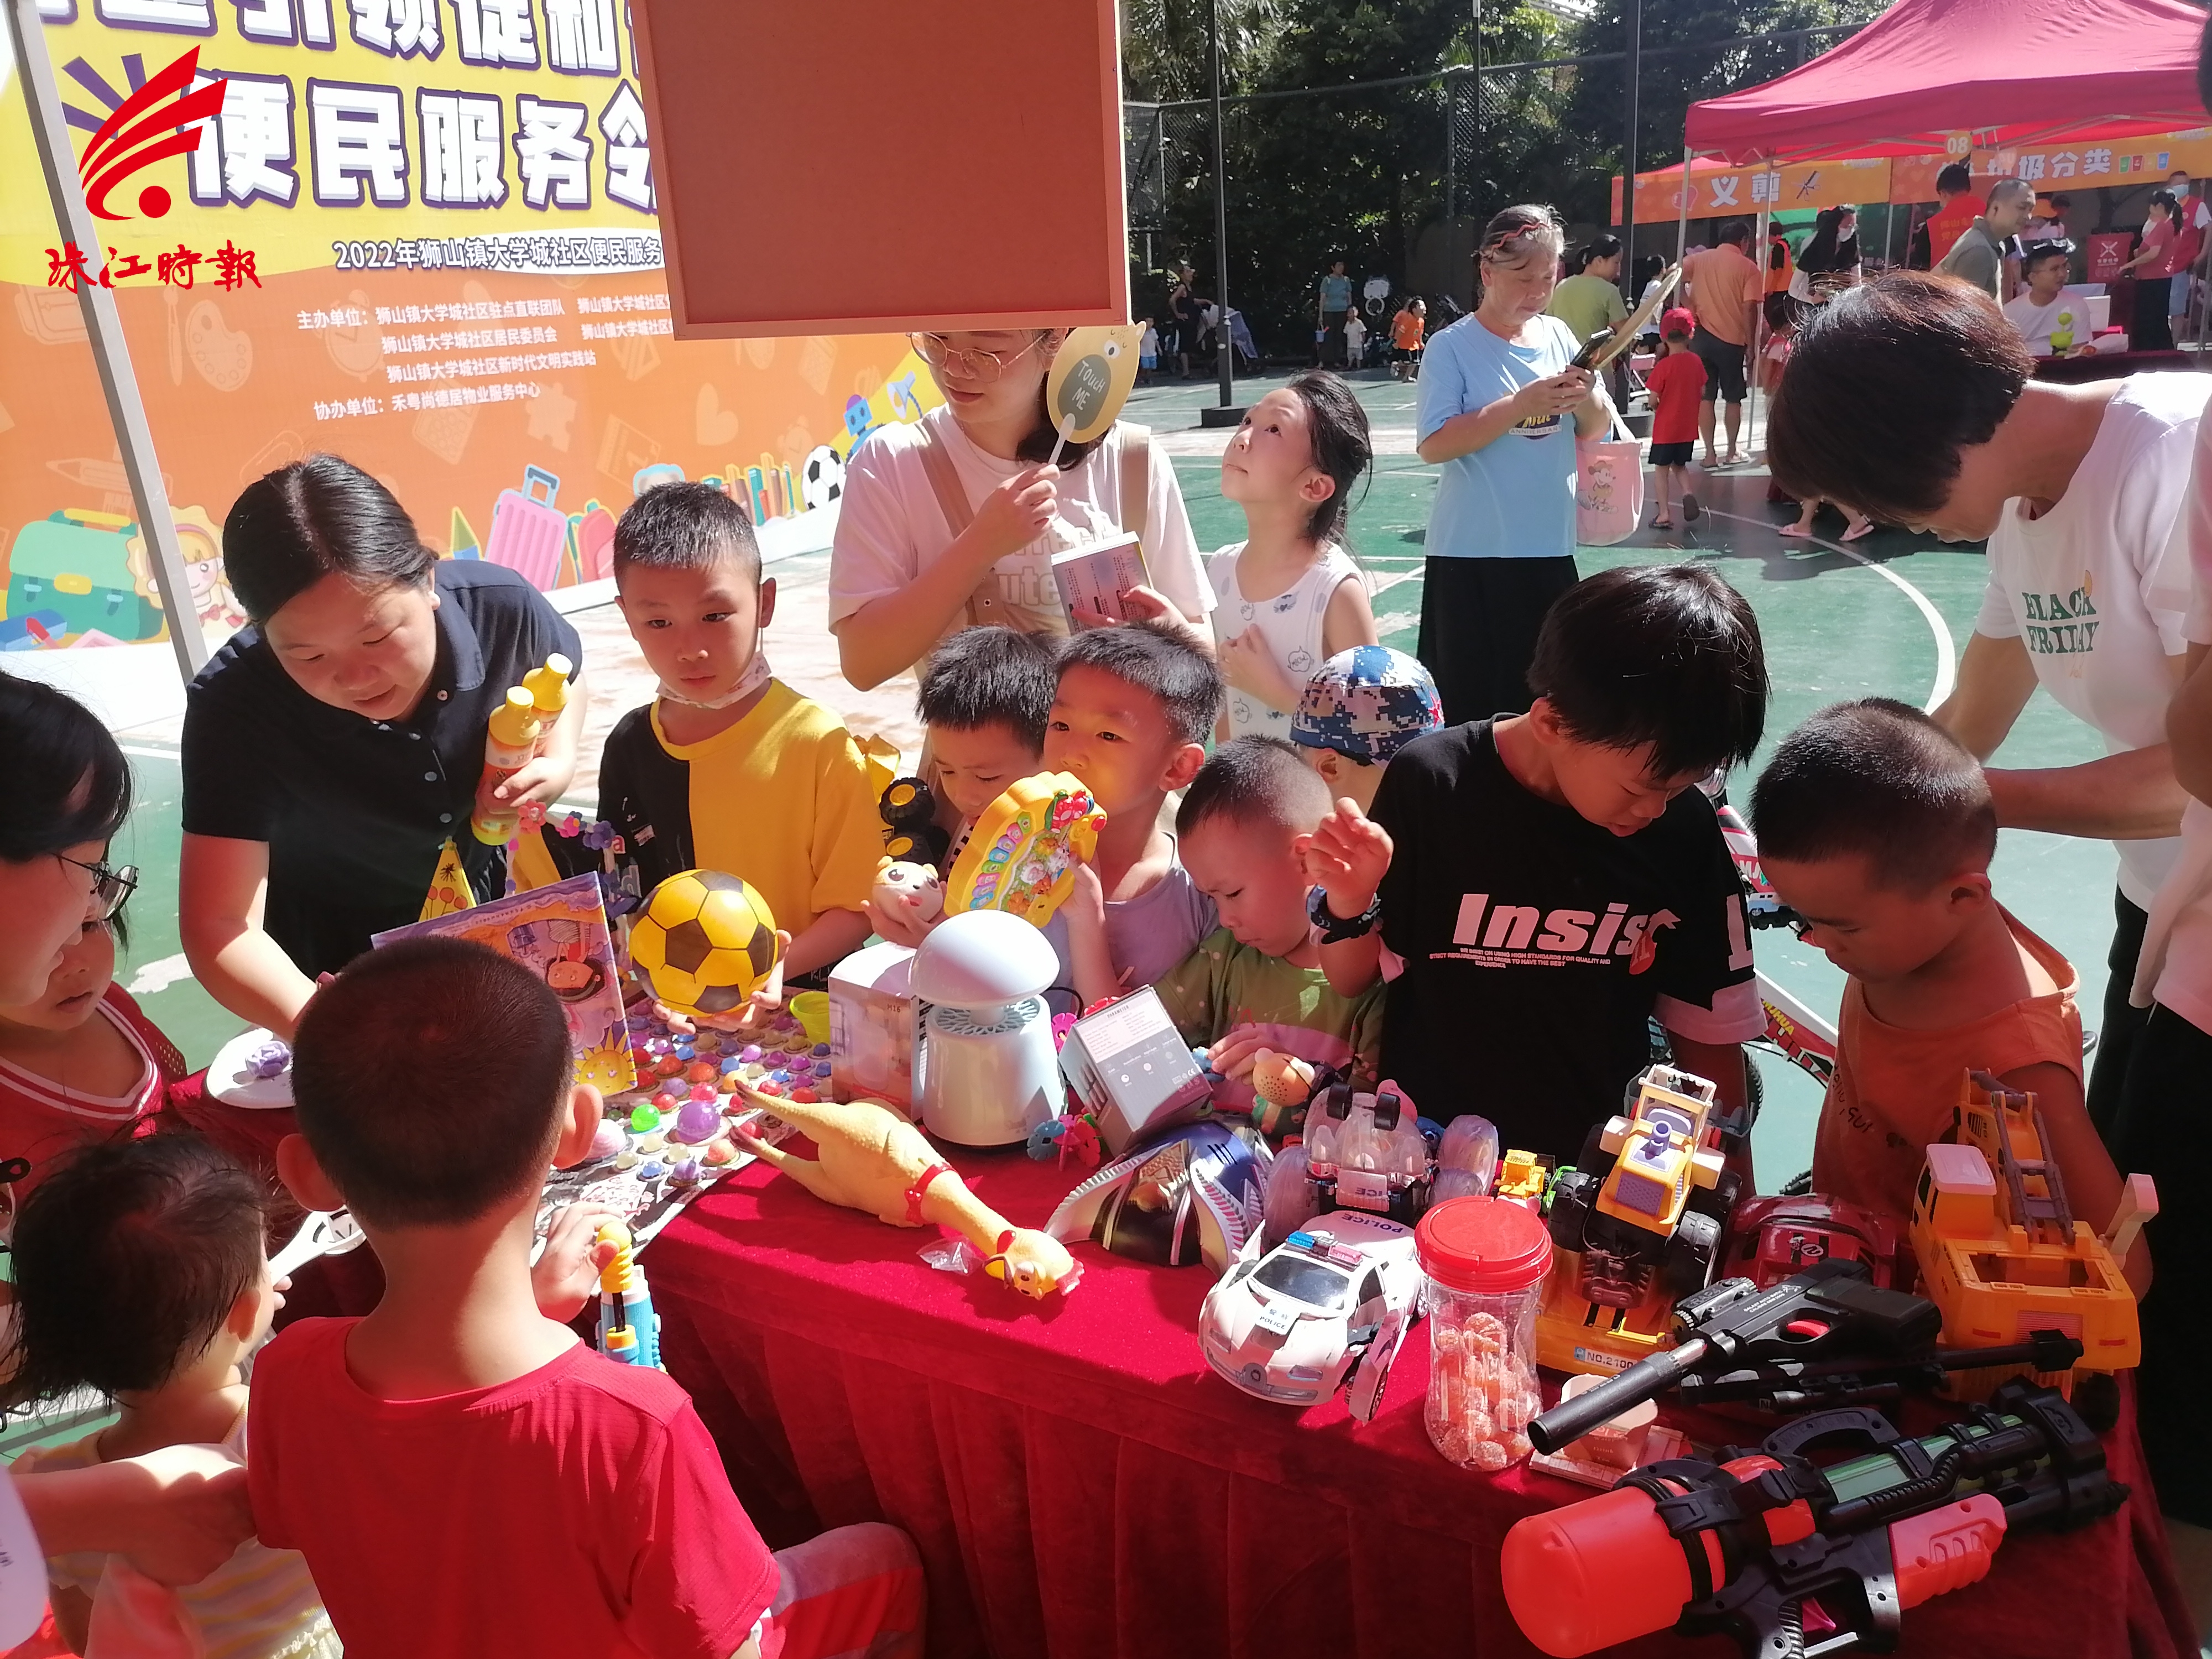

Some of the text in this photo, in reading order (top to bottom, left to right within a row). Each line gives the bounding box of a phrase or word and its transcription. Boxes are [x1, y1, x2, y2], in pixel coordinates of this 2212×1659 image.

[1078, 360, 1106, 393] TOUCH
[1072, 387, 1090, 410] ME
[2022, 587, 2096, 621] BLACK
[2026, 621, 2100, 654] FRIDAY
[1342, 1213, 1404, 1233] POLICE
